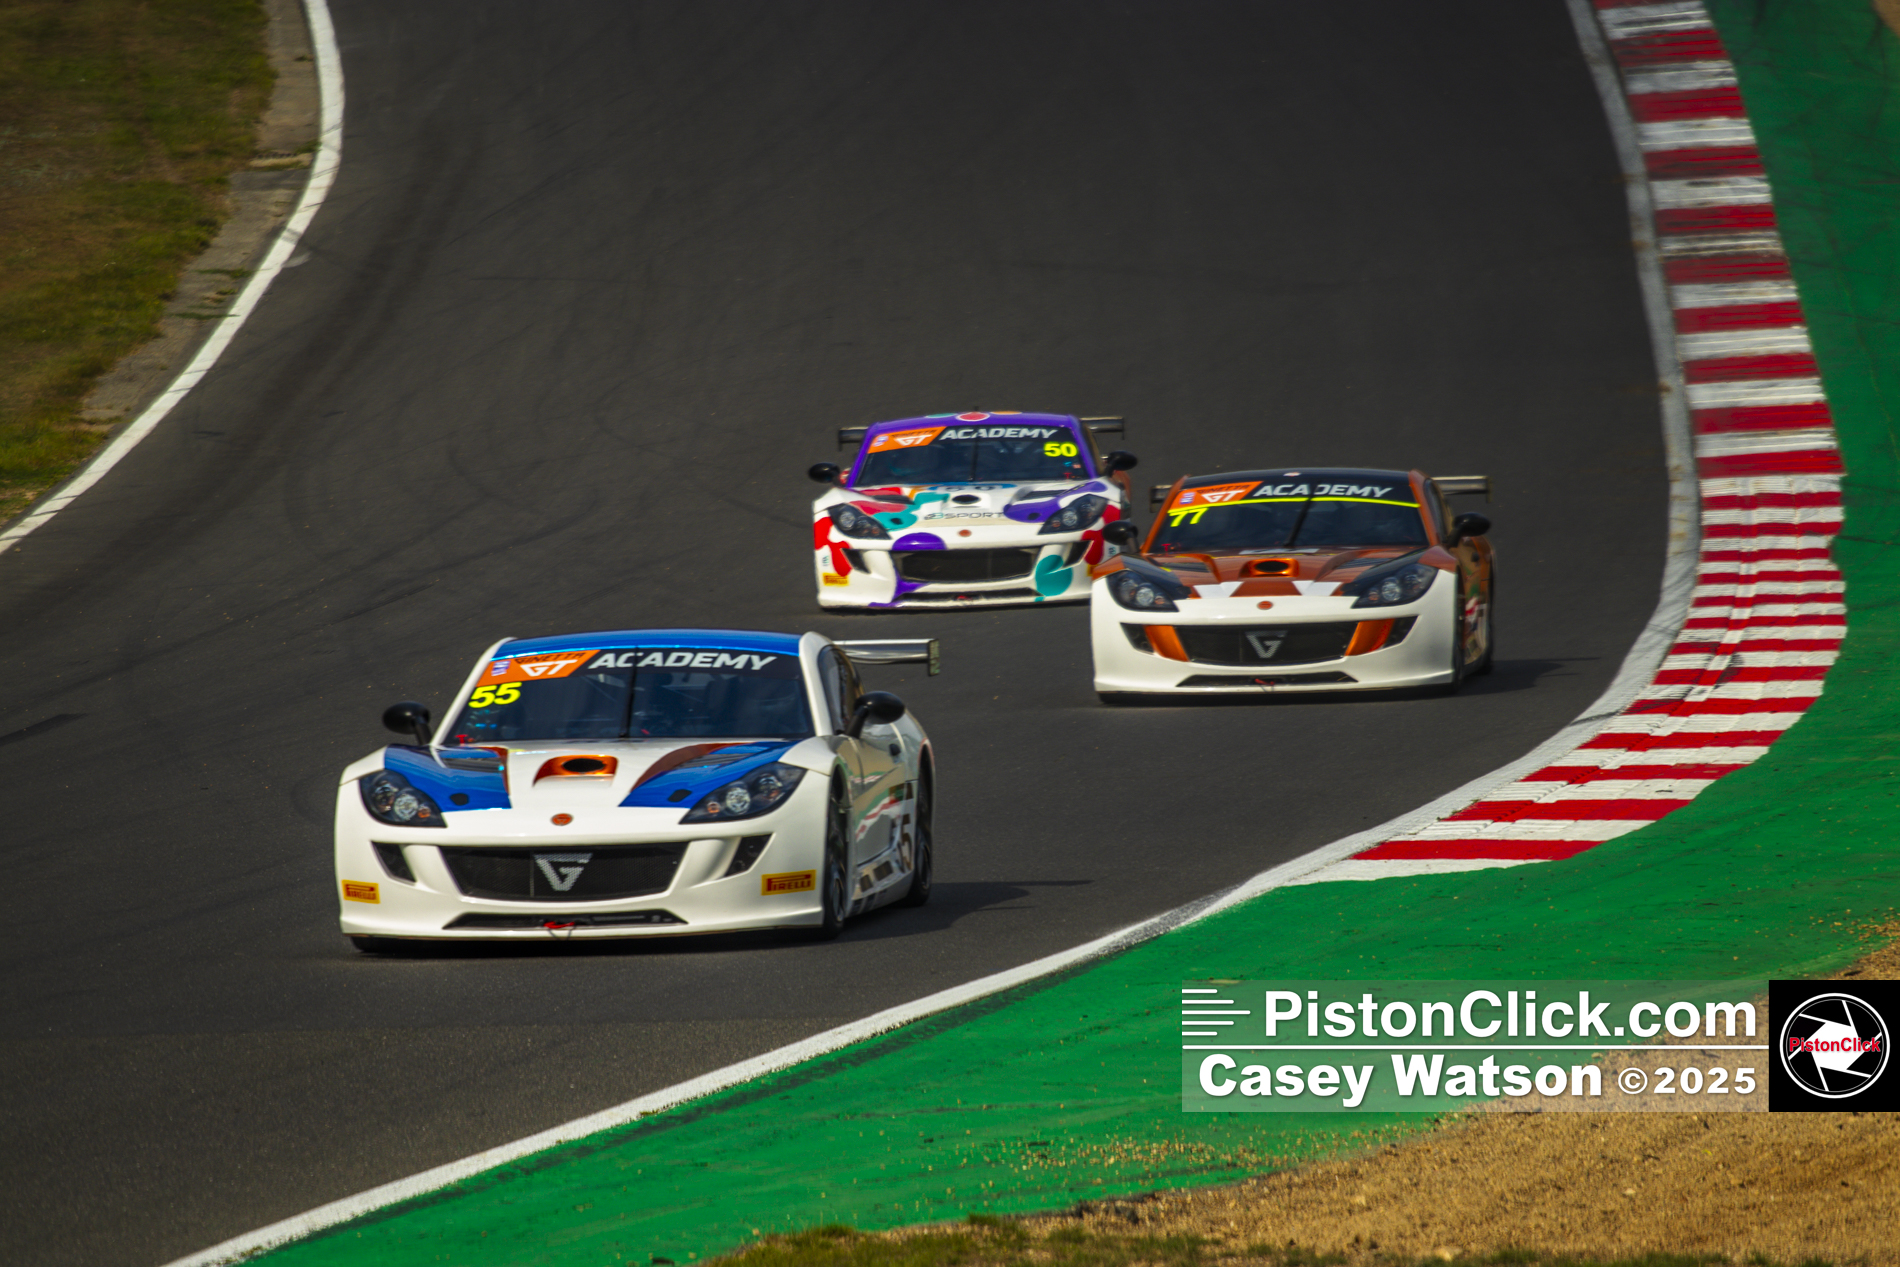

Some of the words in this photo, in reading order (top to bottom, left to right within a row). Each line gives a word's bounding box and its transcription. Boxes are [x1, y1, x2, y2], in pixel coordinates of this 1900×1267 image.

[893, 434, 933, 446] GT
[939, 428, 1058, 440] ACADEMY
[1044, 441, 1078, 458] 50
[1201, 489, 1246, 503] GT
[1168, 507, 1209, 528] 77
[519, 659, 578, 677] GT
[588, 652, 778, 671] ACADEMY
[468, 682, 523, 708] 55
[766, 874, 812, 892] PIRELLI
